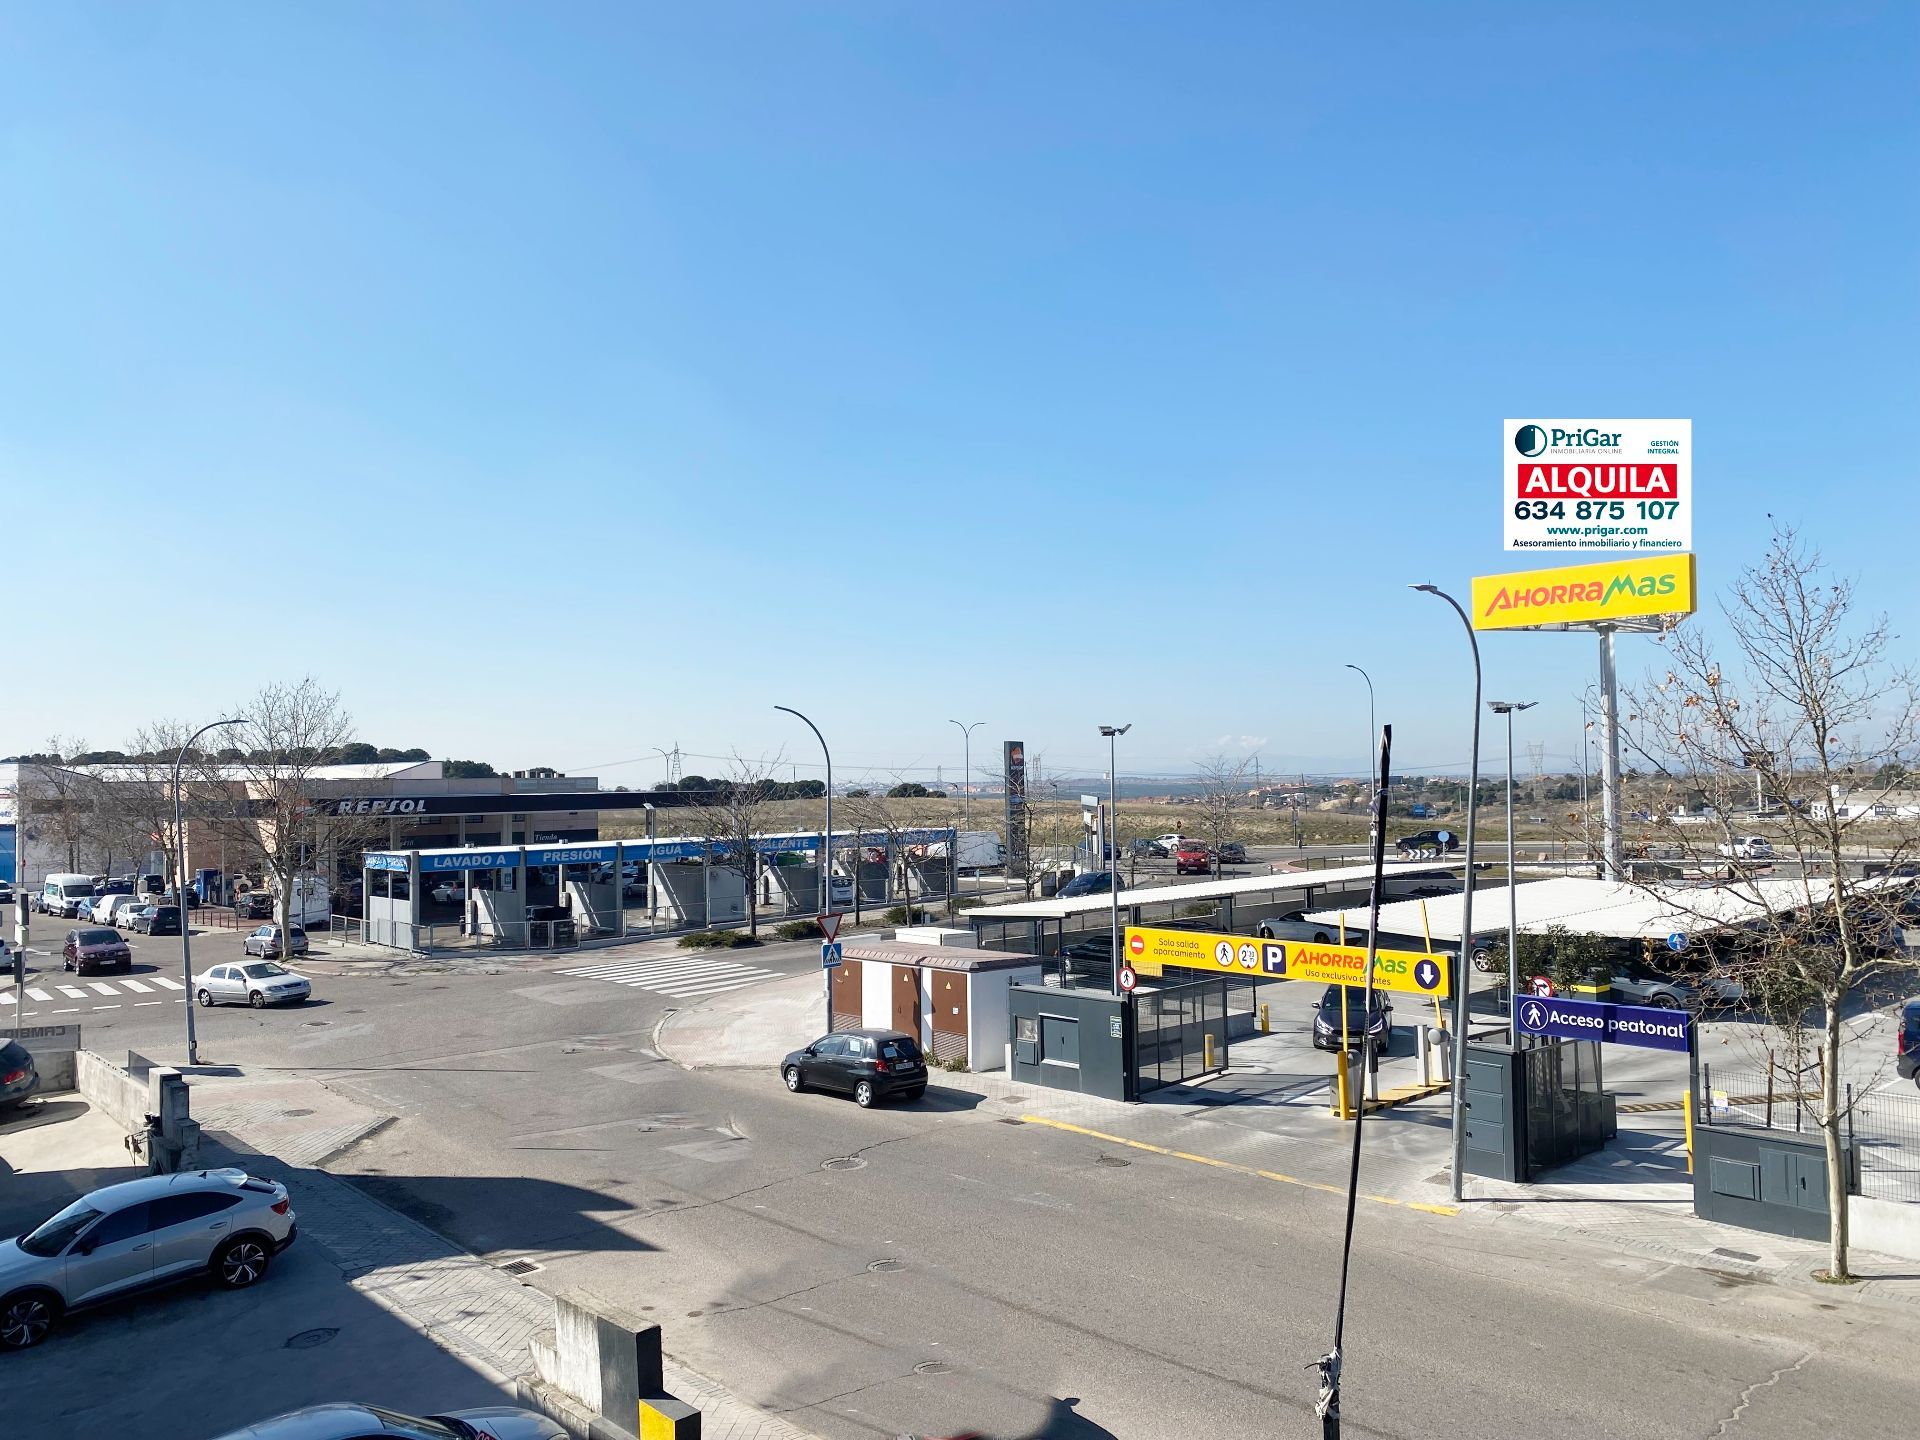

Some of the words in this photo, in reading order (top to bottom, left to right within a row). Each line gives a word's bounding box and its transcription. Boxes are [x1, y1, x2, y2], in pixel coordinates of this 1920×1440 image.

[337, 799, 427, 814] REPSOL
[543, 848, 602, 862] PRESIÓN
[648, 845, 682, 856] AGUA
[433, 855, 493, 868] LAVADO
[496, 855, 507, 865] A
[1176, 939, 1200, 949] salida
[1153, 948, 1206, 960] aparcamiento
[1266, 946, 1283, 971] P
[1305, 968, 1319, 978] Uso
[1321, 970, 1358, 982] exclusivo
[1359, 975, 1391, 986] clntes
[1549, 1010, 1605, 1029] Acceso
[1608, 1018, 1685, 1039] peatonal
